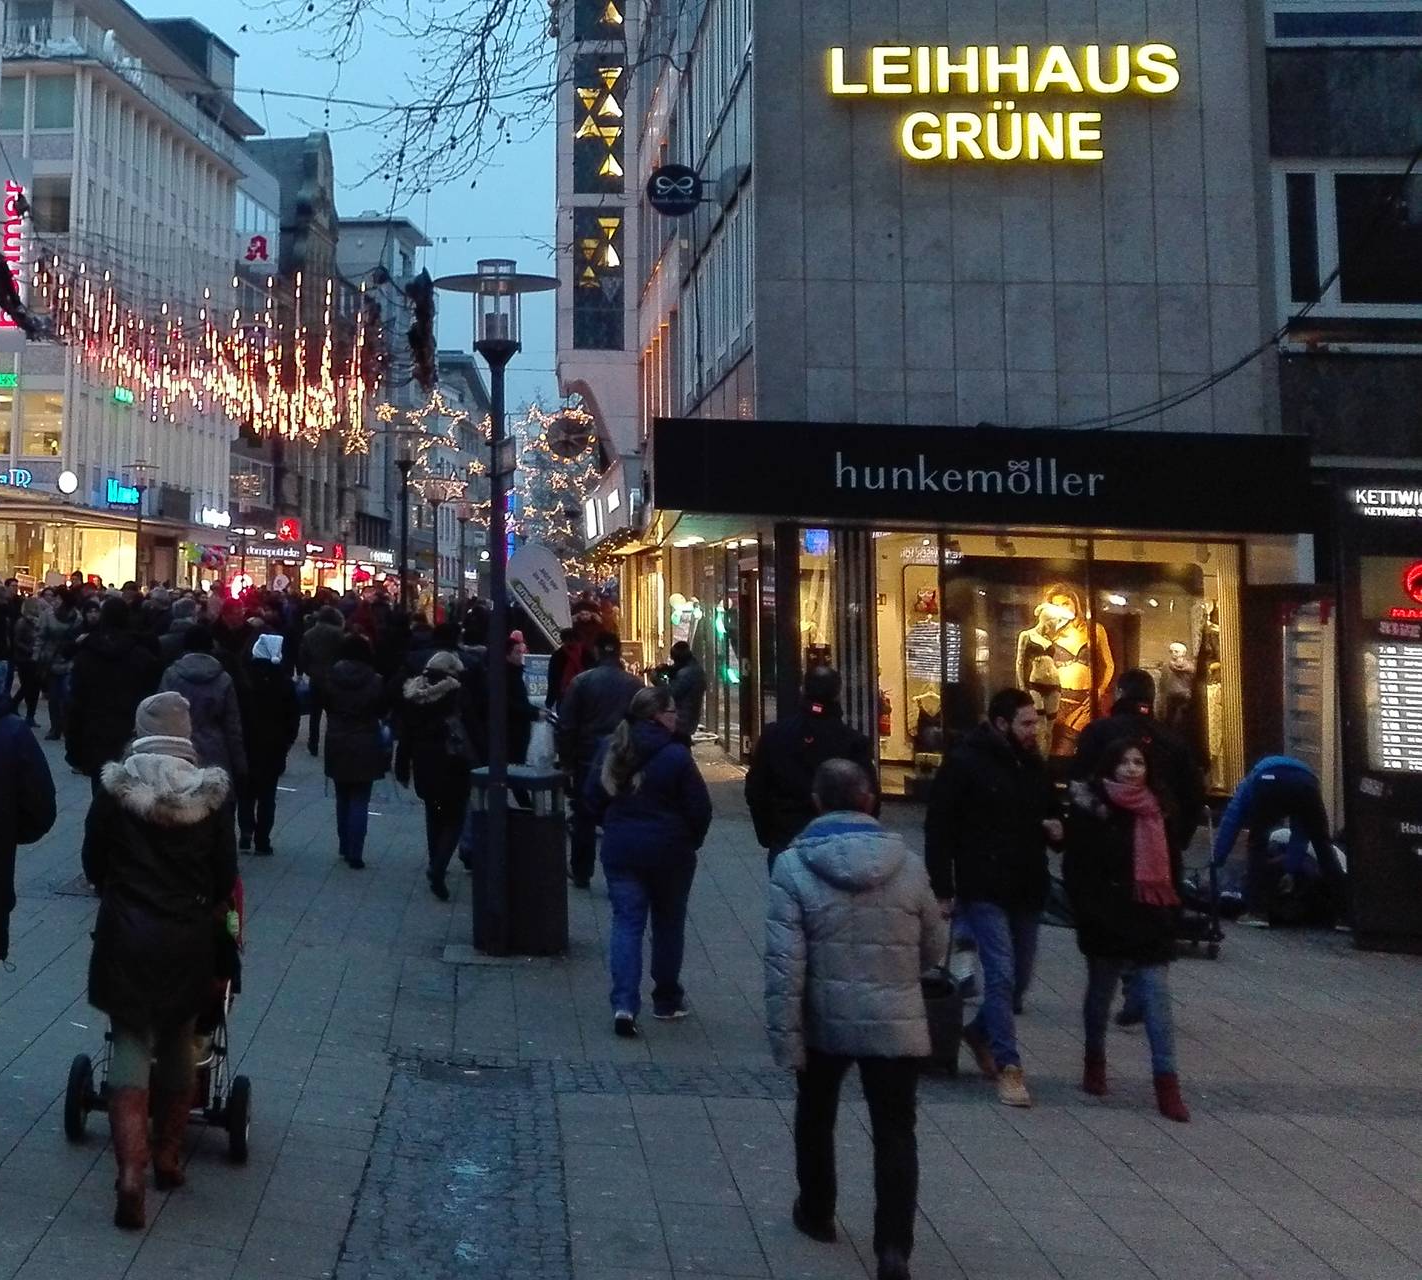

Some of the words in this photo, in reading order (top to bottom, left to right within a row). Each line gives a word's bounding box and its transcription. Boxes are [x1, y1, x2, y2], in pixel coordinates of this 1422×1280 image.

[831, 44, 1180, 94] LEIHHAUS
[901, 100, 1104, 160] GRÜNE
[836, 451, 1104, 496] hunkemöller
[1364, 506, 1416, 517] KETTWIGER
